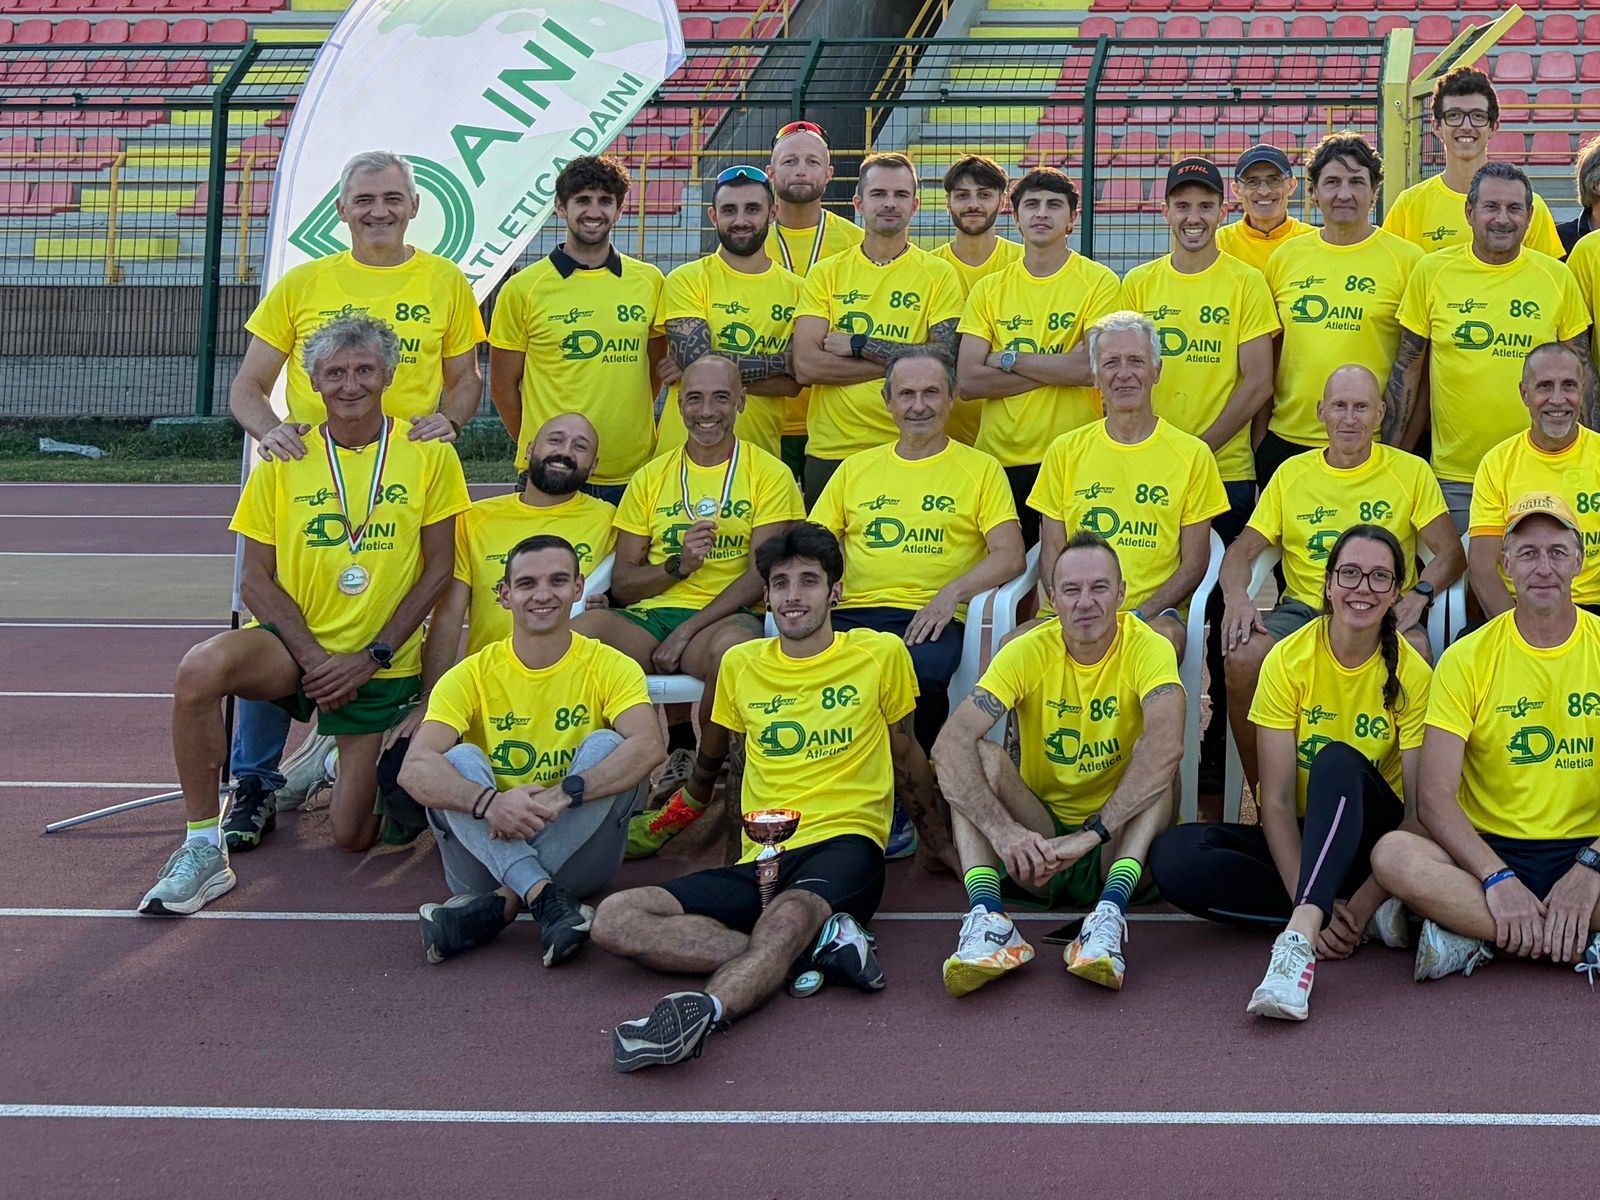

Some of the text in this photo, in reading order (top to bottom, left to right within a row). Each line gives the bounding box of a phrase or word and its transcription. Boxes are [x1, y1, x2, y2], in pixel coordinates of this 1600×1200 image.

[570, 72, 644, 153] DAINI
[1177, 164, 1209, 175] STIHL
[1344, 275, 1375, 292] 80
[890, 290, 920, 309] 80
[1290, 295, 1363, 323] DAINI
[1509, 299, 1539, 318] 80
[396, 303, 430, 321] 80
[617, 305, 644, 322] 80
[1048, 312, 1076, 330] 80
[1200, 306, 1229, 324] 80
[834, 311, 909, 338] DAINI
[1325, 321, 1361, 331] Atletica
[559, 330, 639, 360] DAINI
[1157, 327, 1221, 356] DAINI
[1451, 321, 1532, 350] DAINI
[601, 354, 638, 364] Atletica
[1186, 353, 1220, 363] Atletica
[1492, 347, 1530, 358] Atletic
[921, 495, 955, 512] 80
[1135, 484, 1168, 504] 80
[1359, 500, 1391, 521] 80
[1080, 507, 1157, 538] DAINI
[863, 517, 943, 548] DAINI
[901, 544, 942, 554] Atletica
[1117, 537, 1156, 548] Atletica
[821, 685, 857, 709] 80
[554, 704, 588, 730] 80
[1090, 696, 1117, 721] 80
[1355, 714, 1389, 738] 80
[758, 721, 852, 756] DAINI
[1044, 728, 1120, 765] DAINI
[1507, 726, 1593, 764] DAINI
[490, 740, 579, 775] DAIN
[1078, 755, 1122, 773] Atletica
[1555, 758, 1593, 769] Atletica
[533, 768, 567, 782] Atleti
